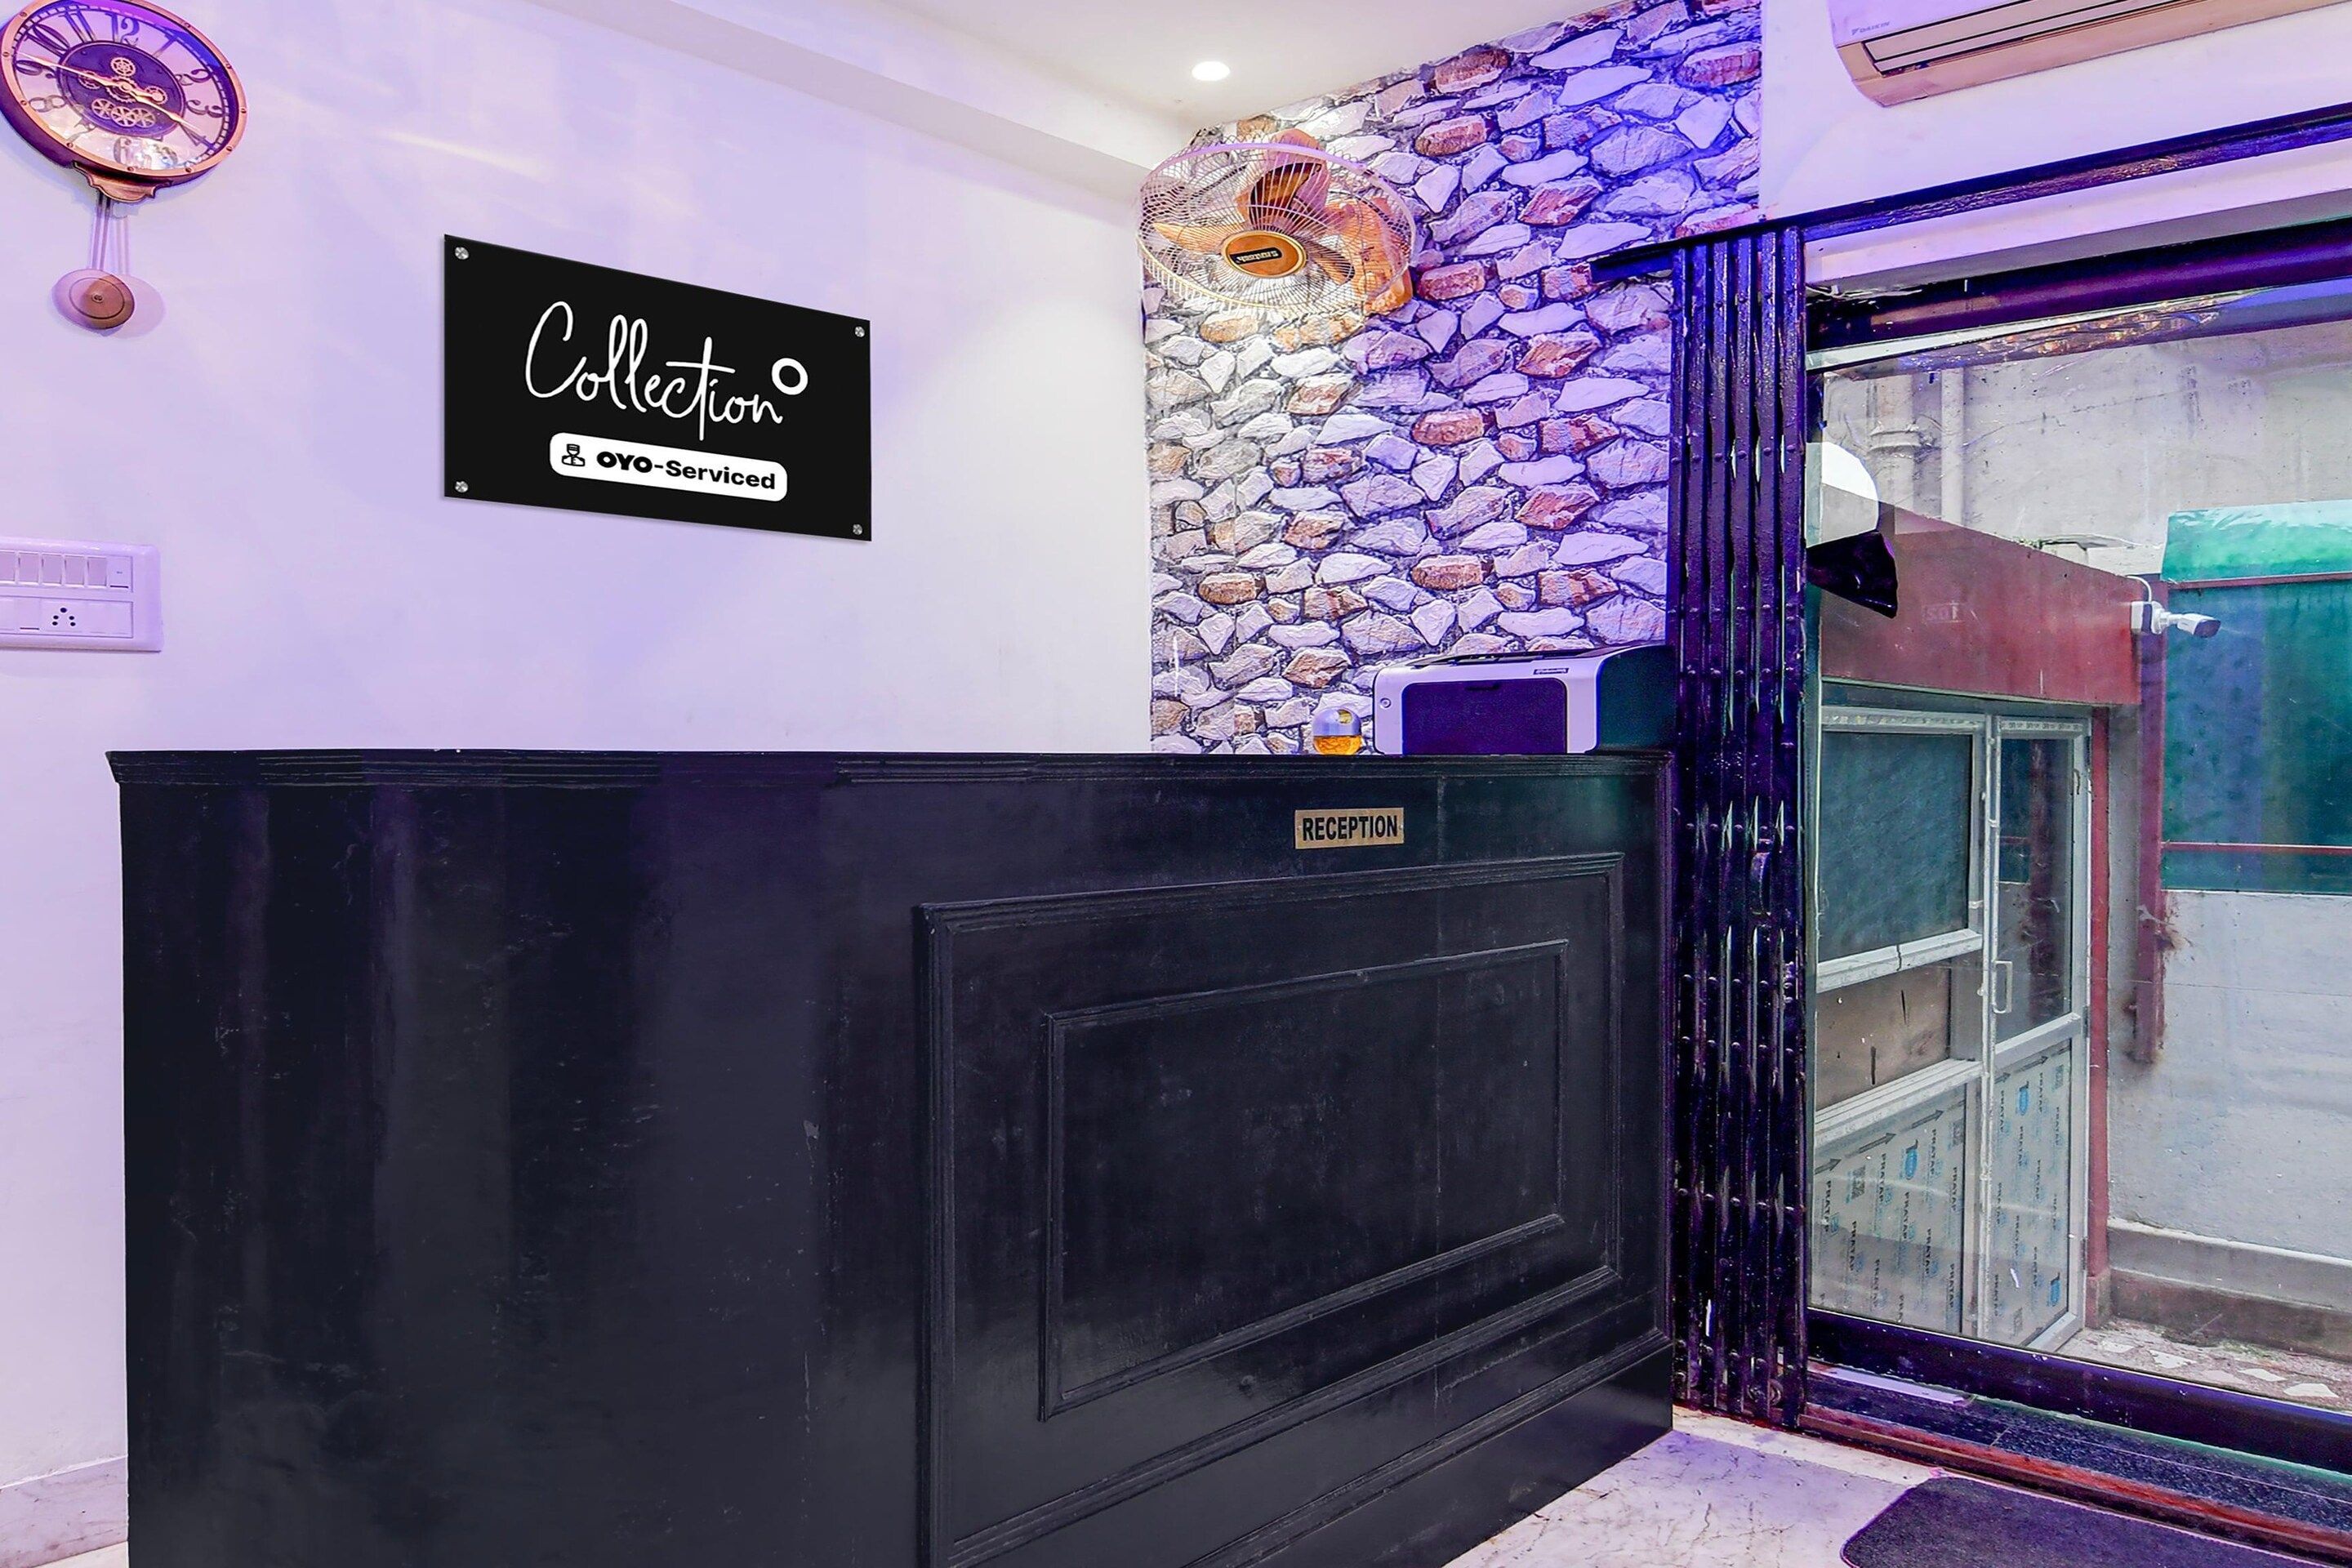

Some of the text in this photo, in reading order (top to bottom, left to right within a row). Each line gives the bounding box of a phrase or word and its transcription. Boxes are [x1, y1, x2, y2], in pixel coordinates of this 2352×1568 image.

[104, 11, 140, 47] 12
[29, 94, 66, 113] 8
[185, 99, 225, 118] 3
[525, 301, 783, 441] Collection
[596, 451, 775, 490] OYO-Serviced
[1303, 815, 1397, 841] RECEPTION
